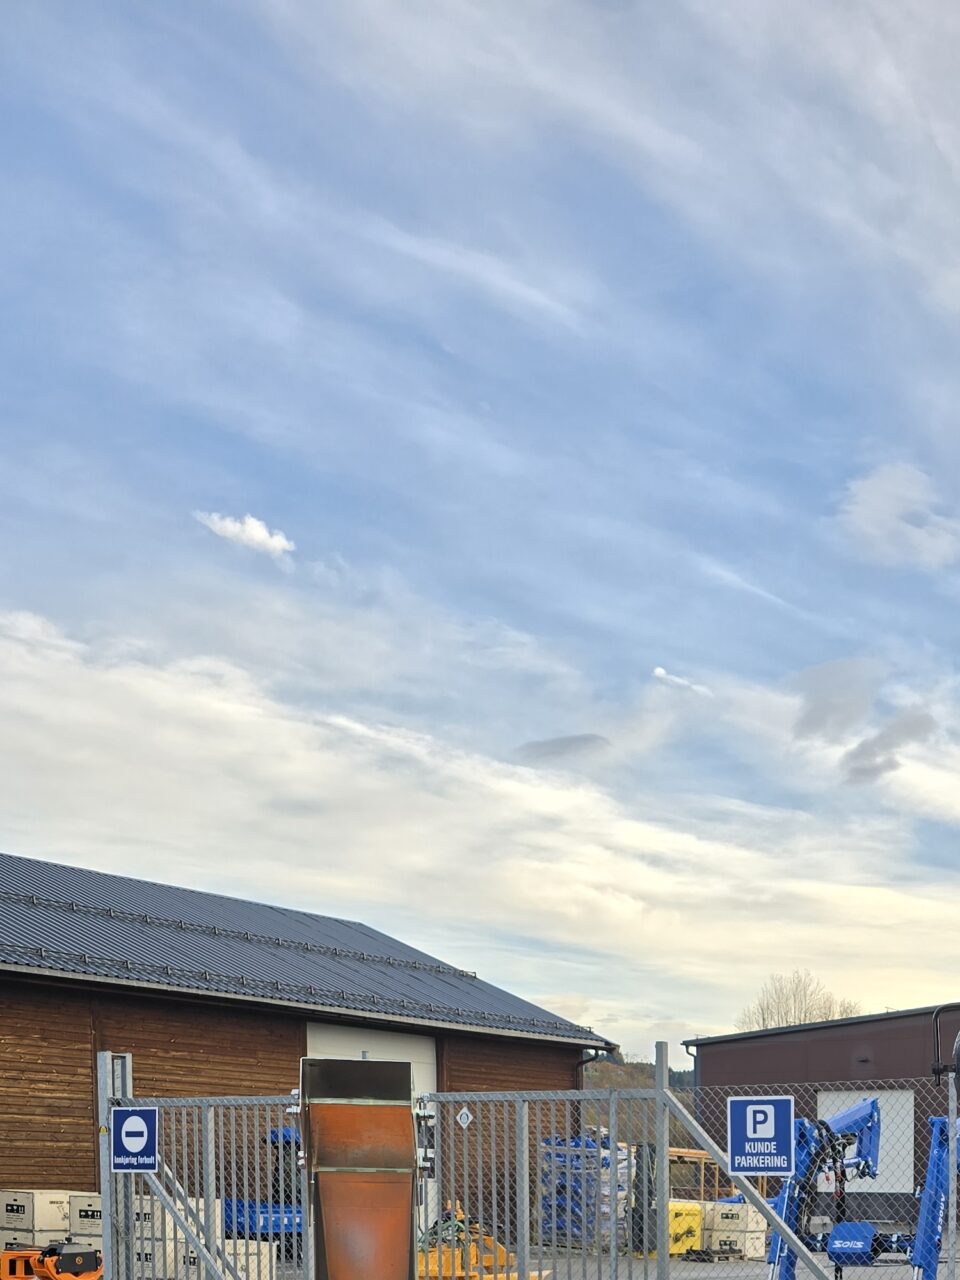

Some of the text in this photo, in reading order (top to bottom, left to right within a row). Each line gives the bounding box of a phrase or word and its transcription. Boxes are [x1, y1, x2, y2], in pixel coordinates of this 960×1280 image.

[752, 1109, 769, 1135] P
[745, 1141, 777, 1153] KUNDE
[734, 1155, 788, 1168] PARKERING
